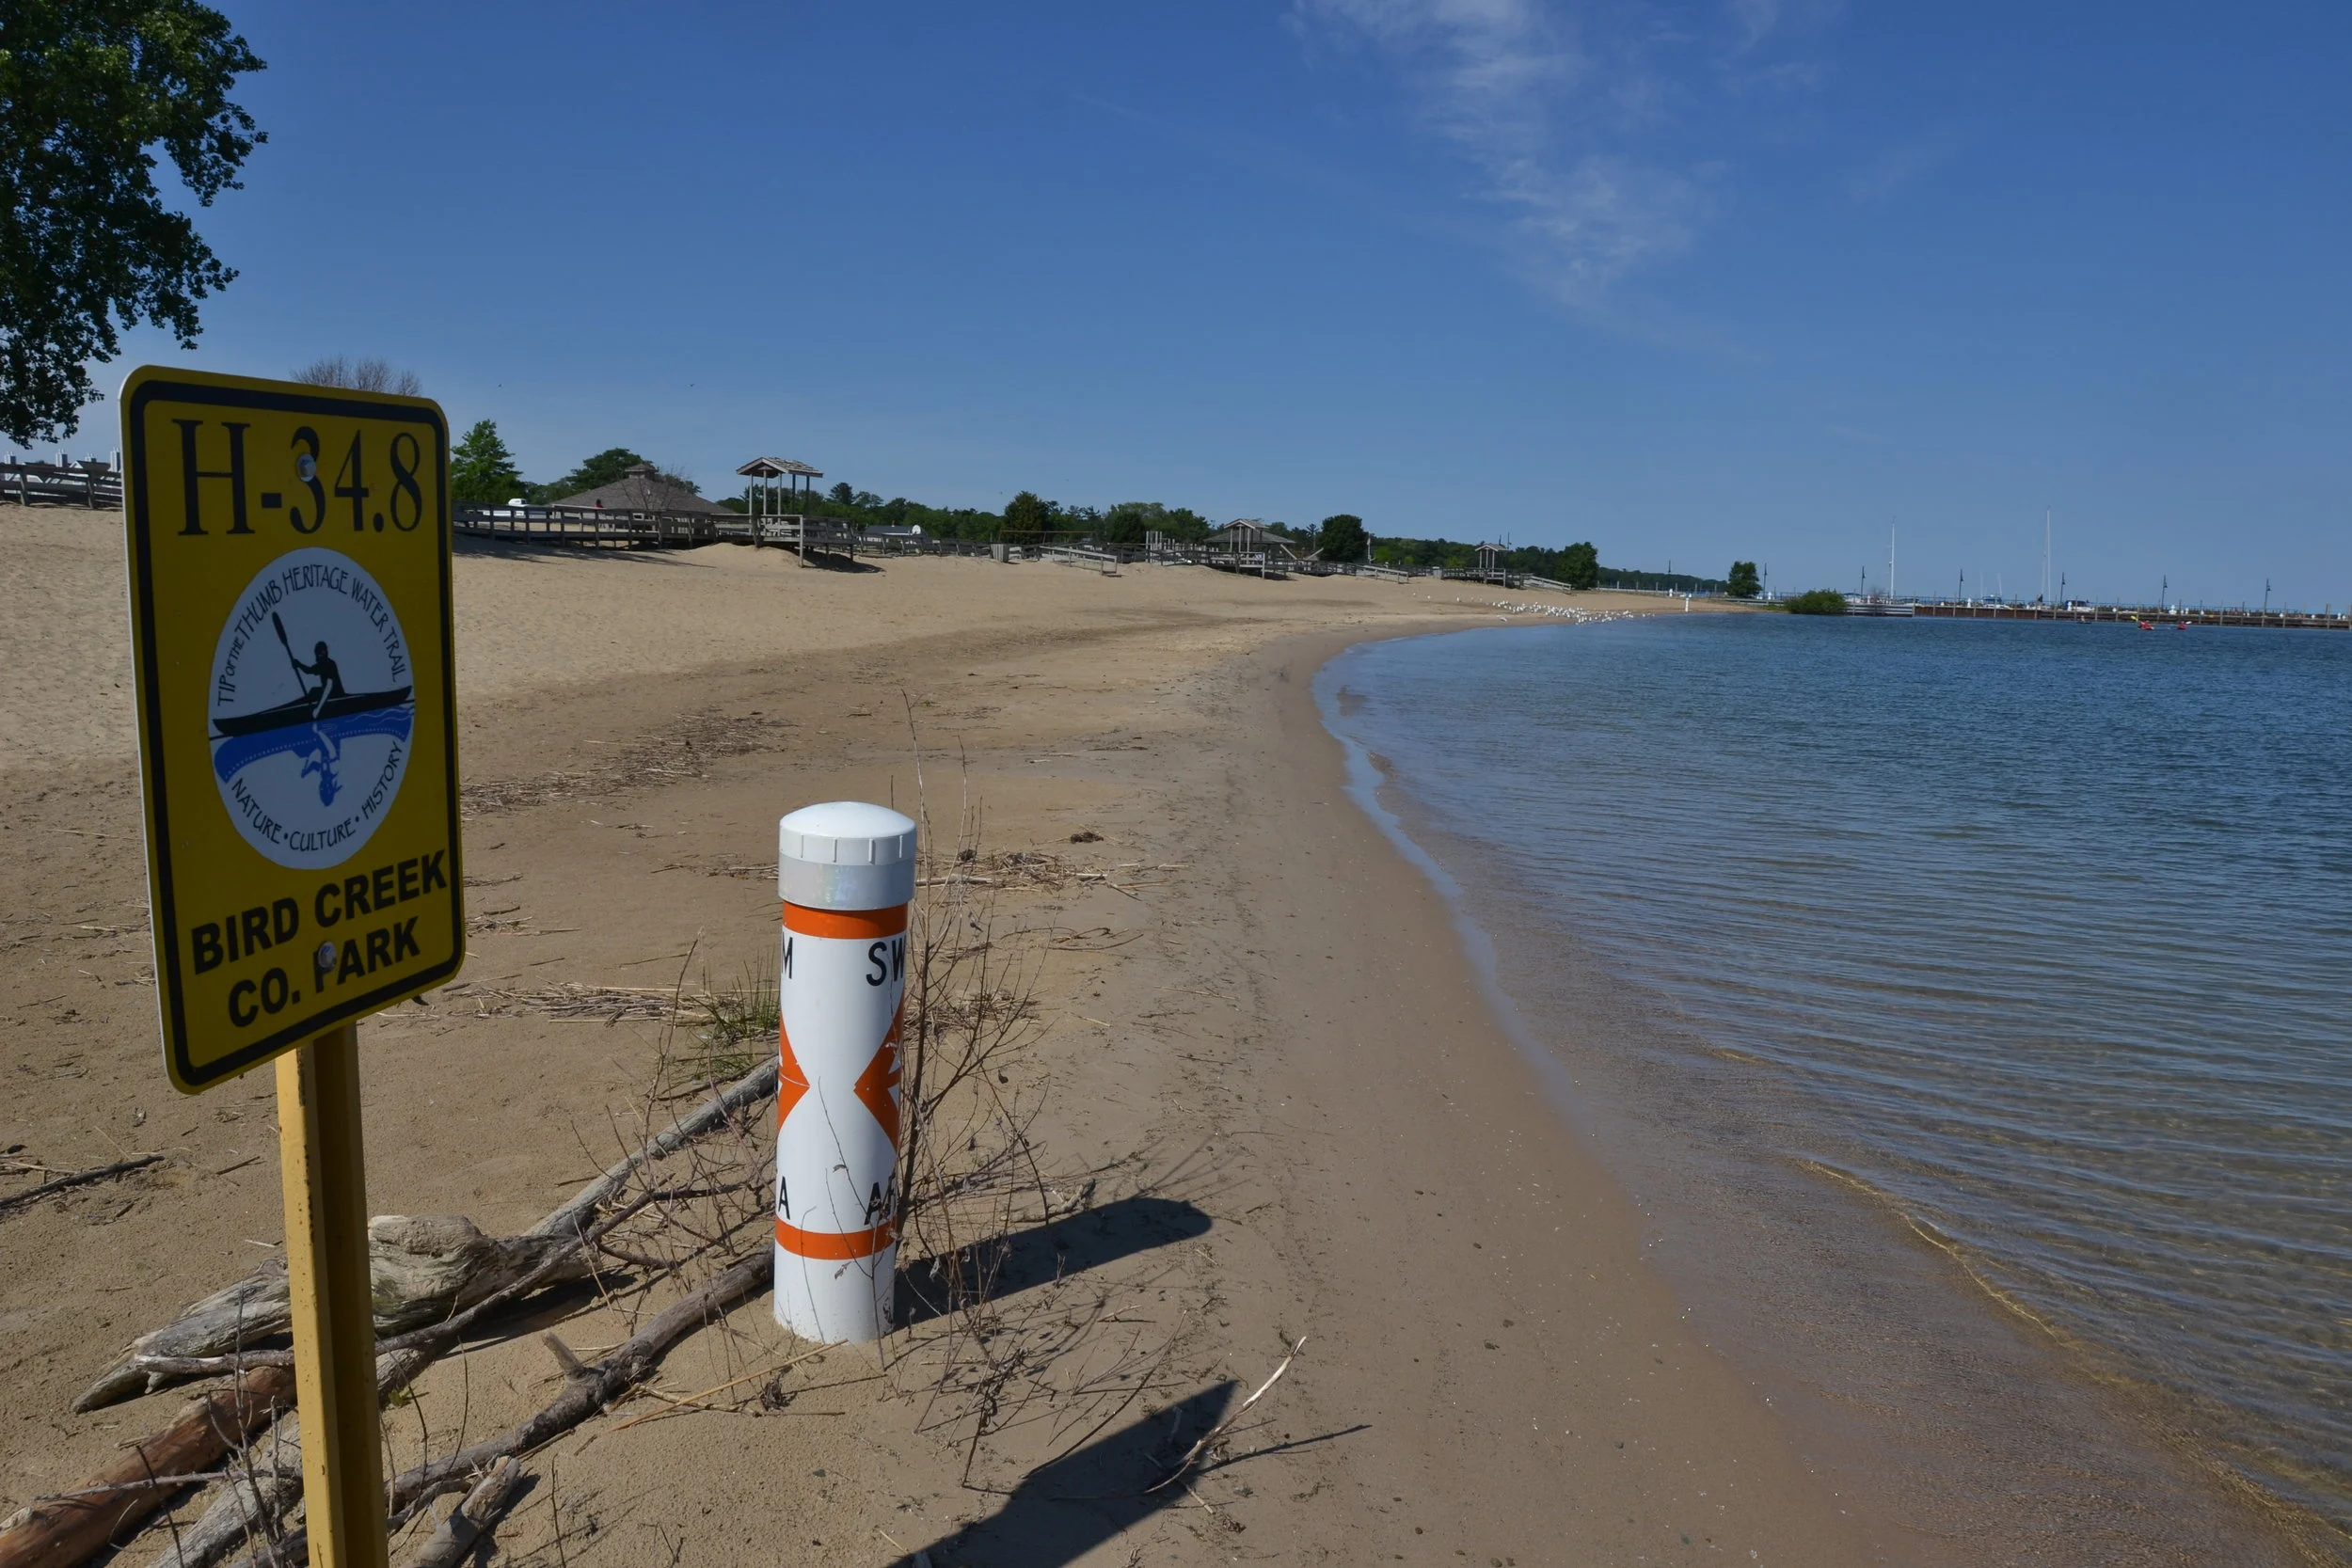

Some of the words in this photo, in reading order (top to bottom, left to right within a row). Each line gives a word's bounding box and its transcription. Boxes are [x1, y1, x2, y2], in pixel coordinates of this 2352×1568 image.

[171, 418, 422, 535] H-34.8
[282, 564, 349, 594] HERITAGE
[352, 578, 389, 633] WATER
[234, 579, 282, 641] THUMB
[230, 636, 245, 660] THE
[384, 626, 406, 683] TRAIL
[217, 674, 236, 706] TIP
[231, 778, 282, 845] NATURE
[290, 817, 356, 852] CULTURE
[361, 740, 403, 819] HISTORY
[191, 896, 299, 975] BIRD
[313, 848, 447, 928] CREEK
[228, 966, 301, 1028] CO.
